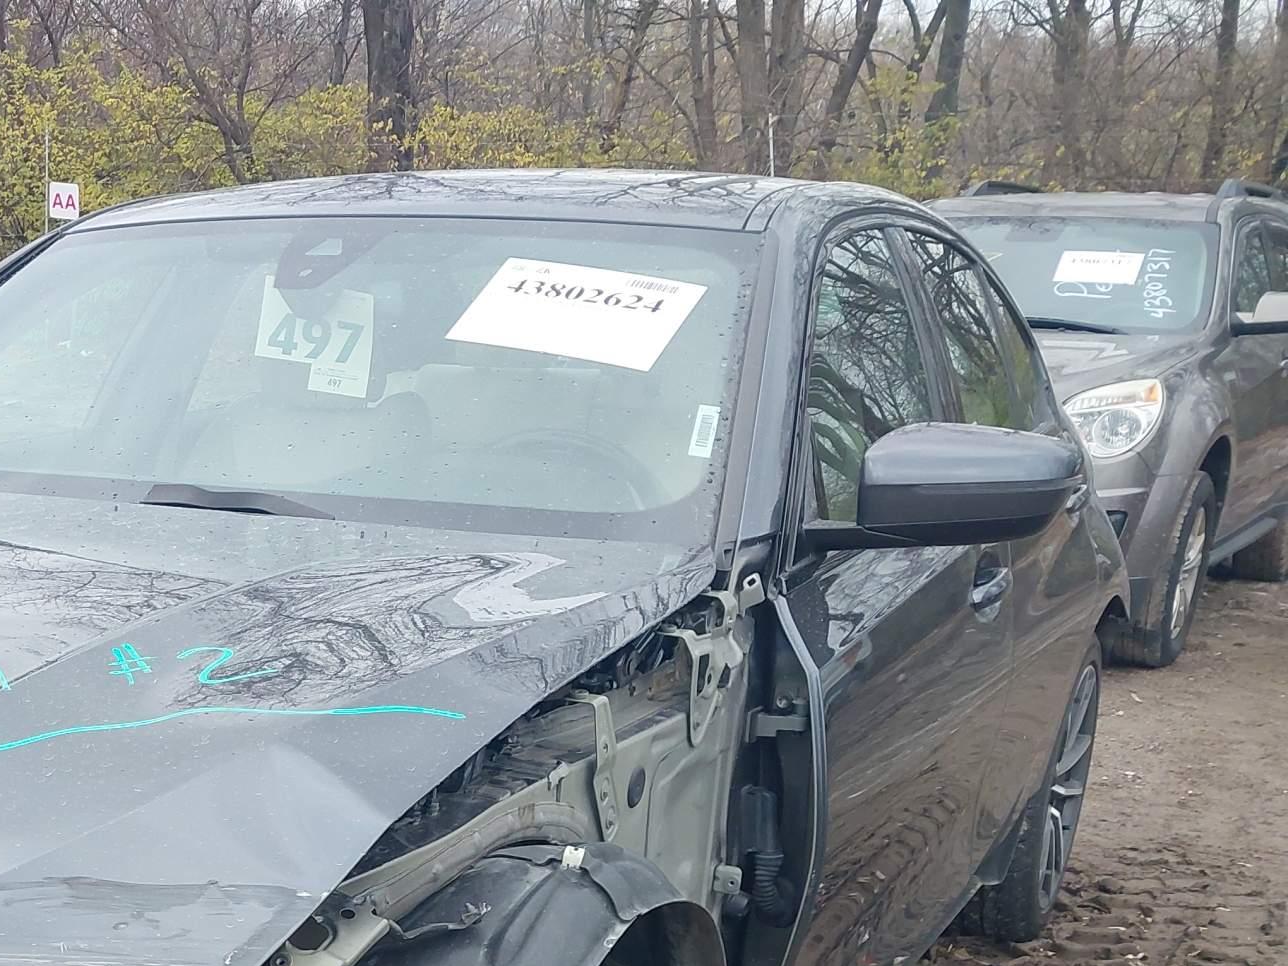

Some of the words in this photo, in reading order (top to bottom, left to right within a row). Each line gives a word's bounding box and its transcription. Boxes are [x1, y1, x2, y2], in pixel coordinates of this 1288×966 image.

[52, 193, 76, 210] AA
[507, 278, 665, 313] 43802624
[1143, 248, 1177, 318] 43807317
[267, 312, 365, 363] 497
